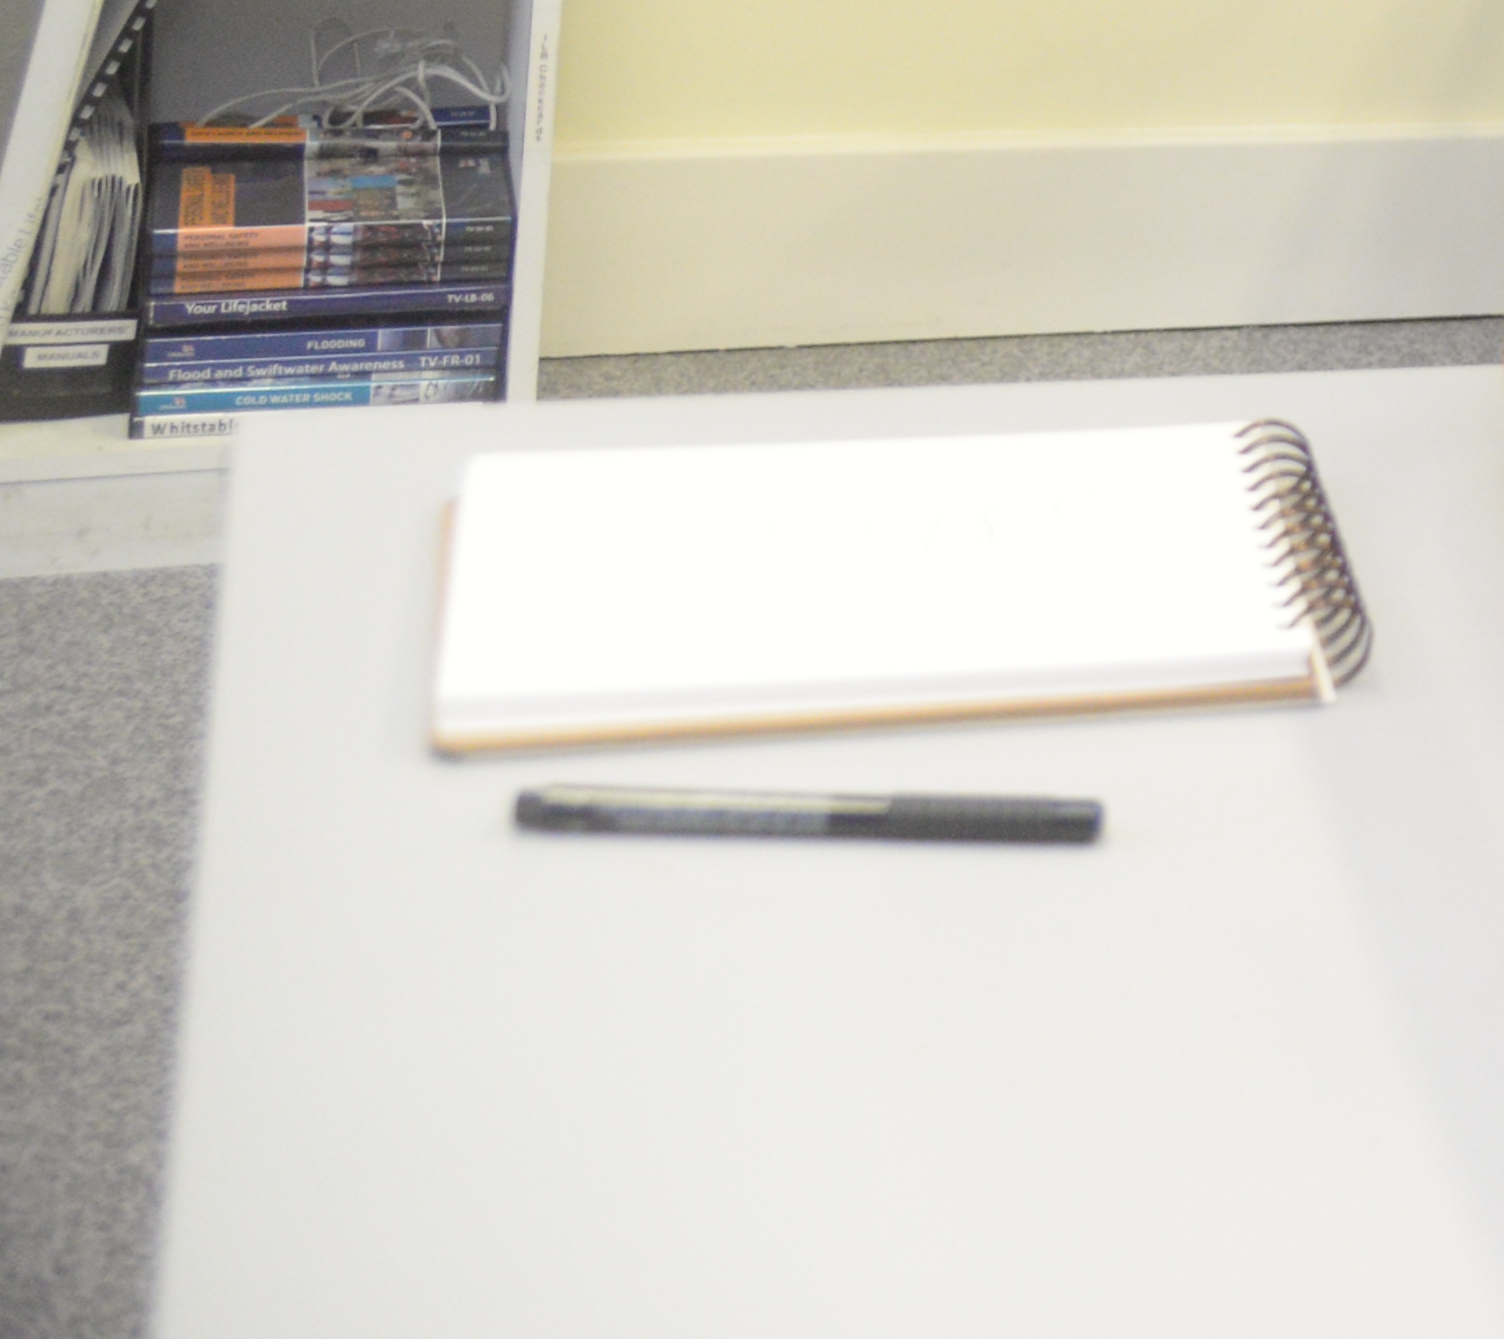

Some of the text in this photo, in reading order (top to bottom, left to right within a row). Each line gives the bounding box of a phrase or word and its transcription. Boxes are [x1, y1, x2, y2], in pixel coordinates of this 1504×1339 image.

[185, 291, 494, 315] Your Lifejacket TV-LB-06
[306, 338, 366, 350] FLOODING
[169, 354, 482, 381] Flood and Swiftwater Awareness TV-FR-01
[235, 391, 353, 406] COLD WATER SHOCK
[151, 418, 234, 437] Whitstabl
